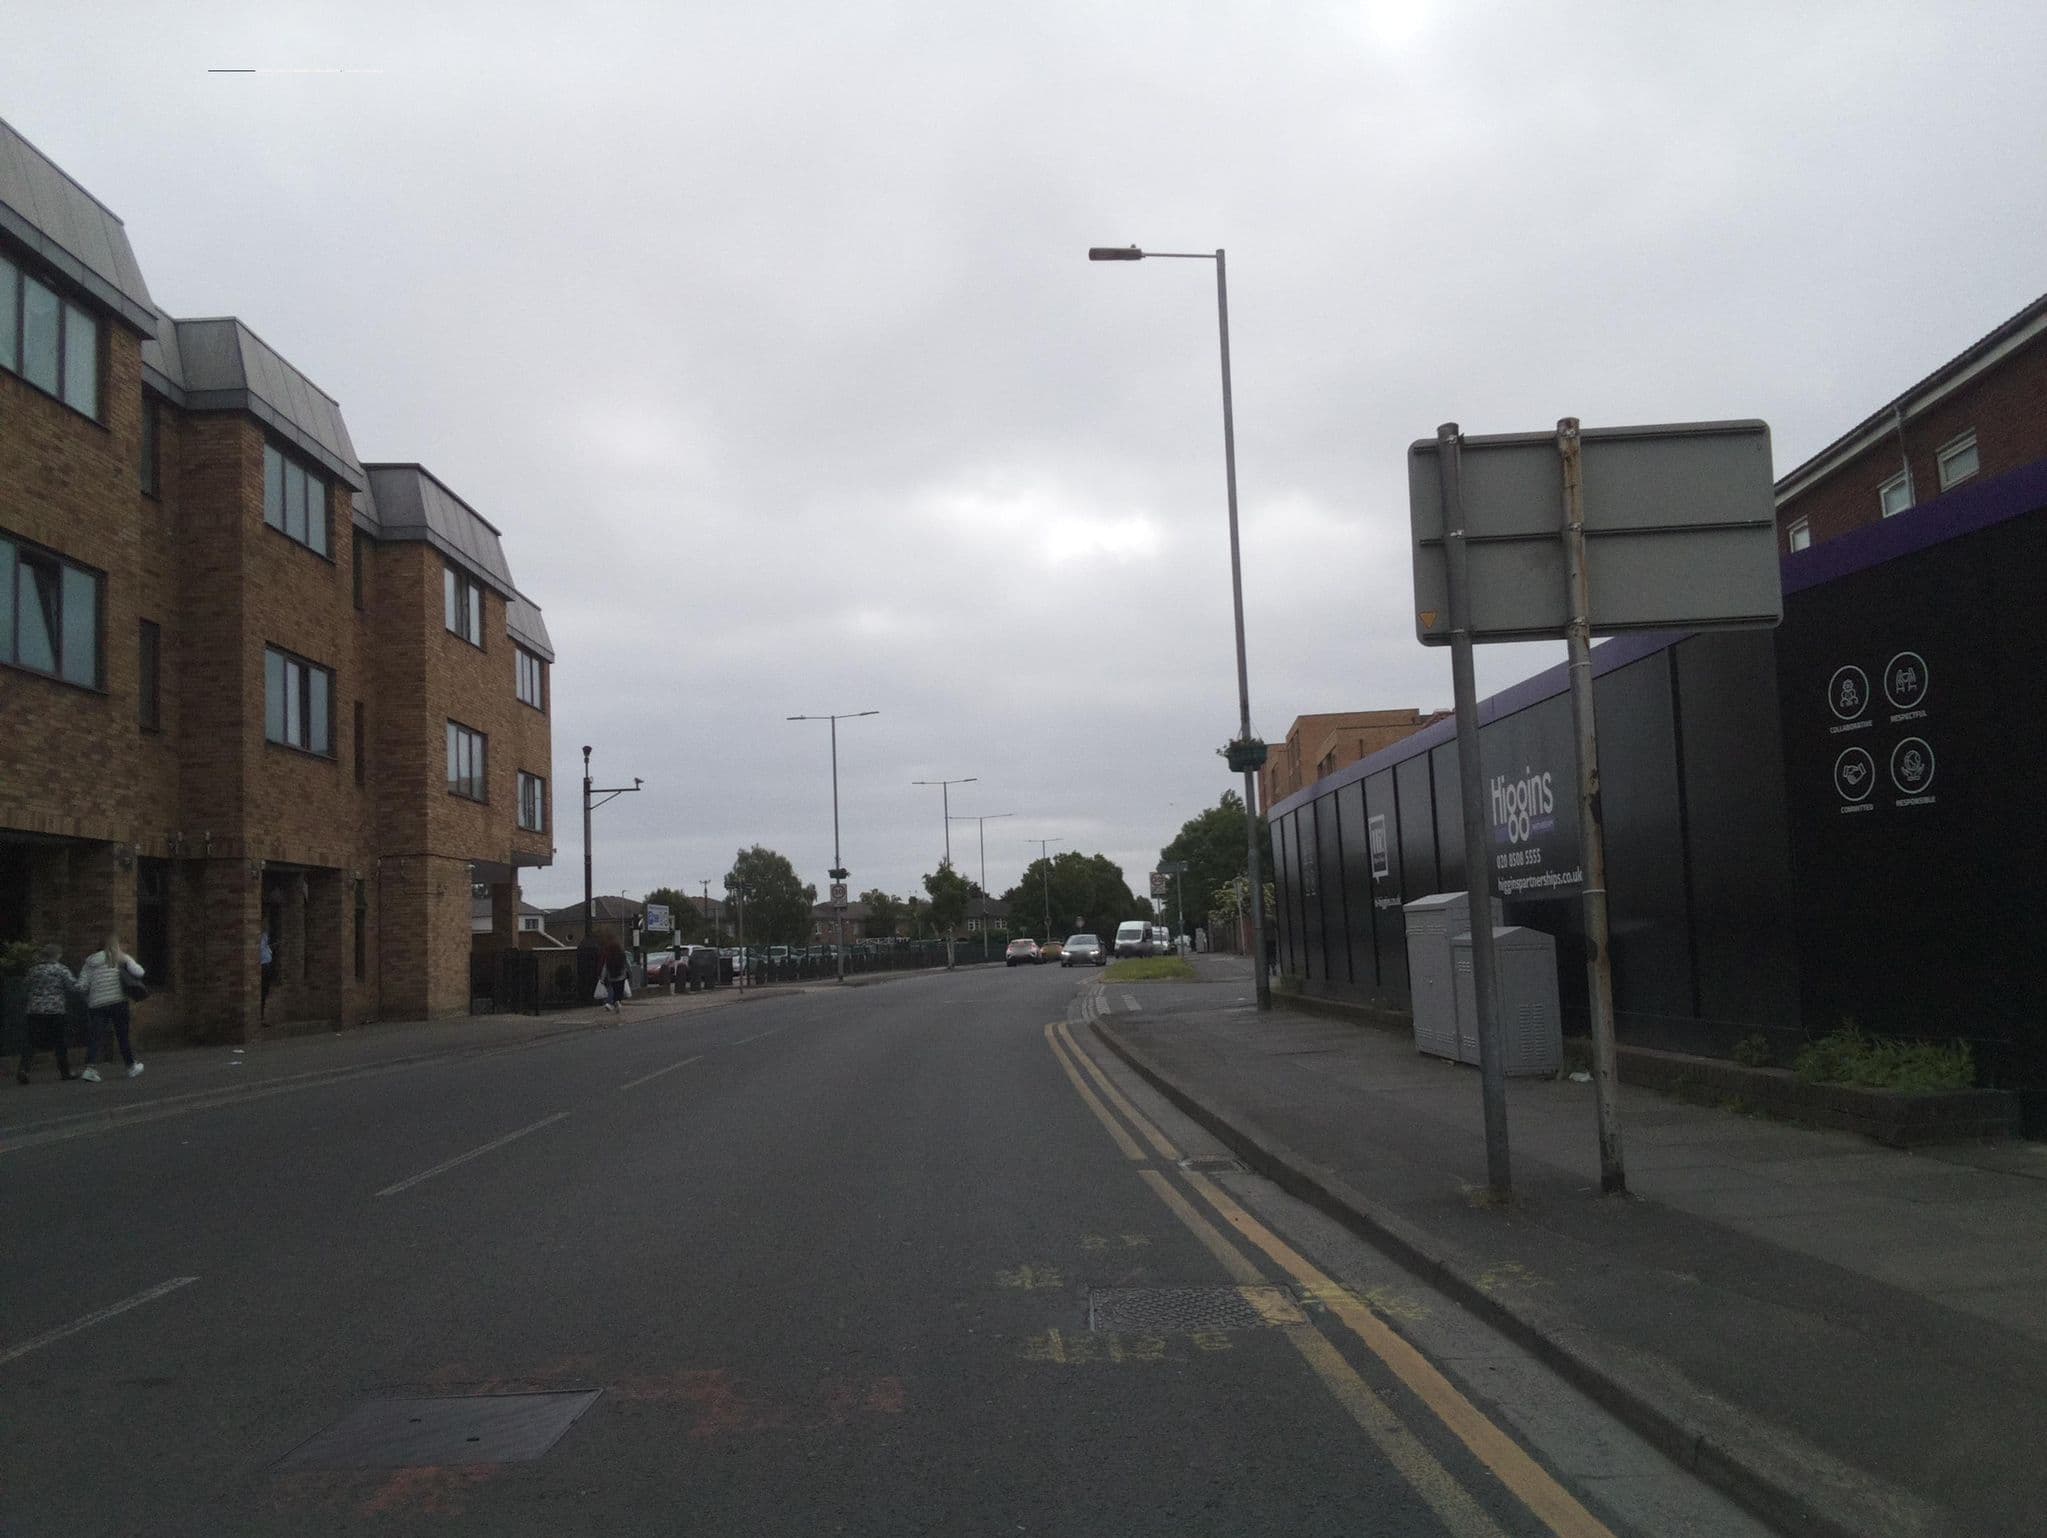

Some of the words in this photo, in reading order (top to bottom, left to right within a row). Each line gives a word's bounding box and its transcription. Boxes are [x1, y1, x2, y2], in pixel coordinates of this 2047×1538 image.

[1491, 766, 1554, 843] Higgins
[1496, 854, 1508, 869] 020
[1525, 848, 1541, 865] 5555
[1498, 866, 1583, 895] higginspartnerships.co.uk
